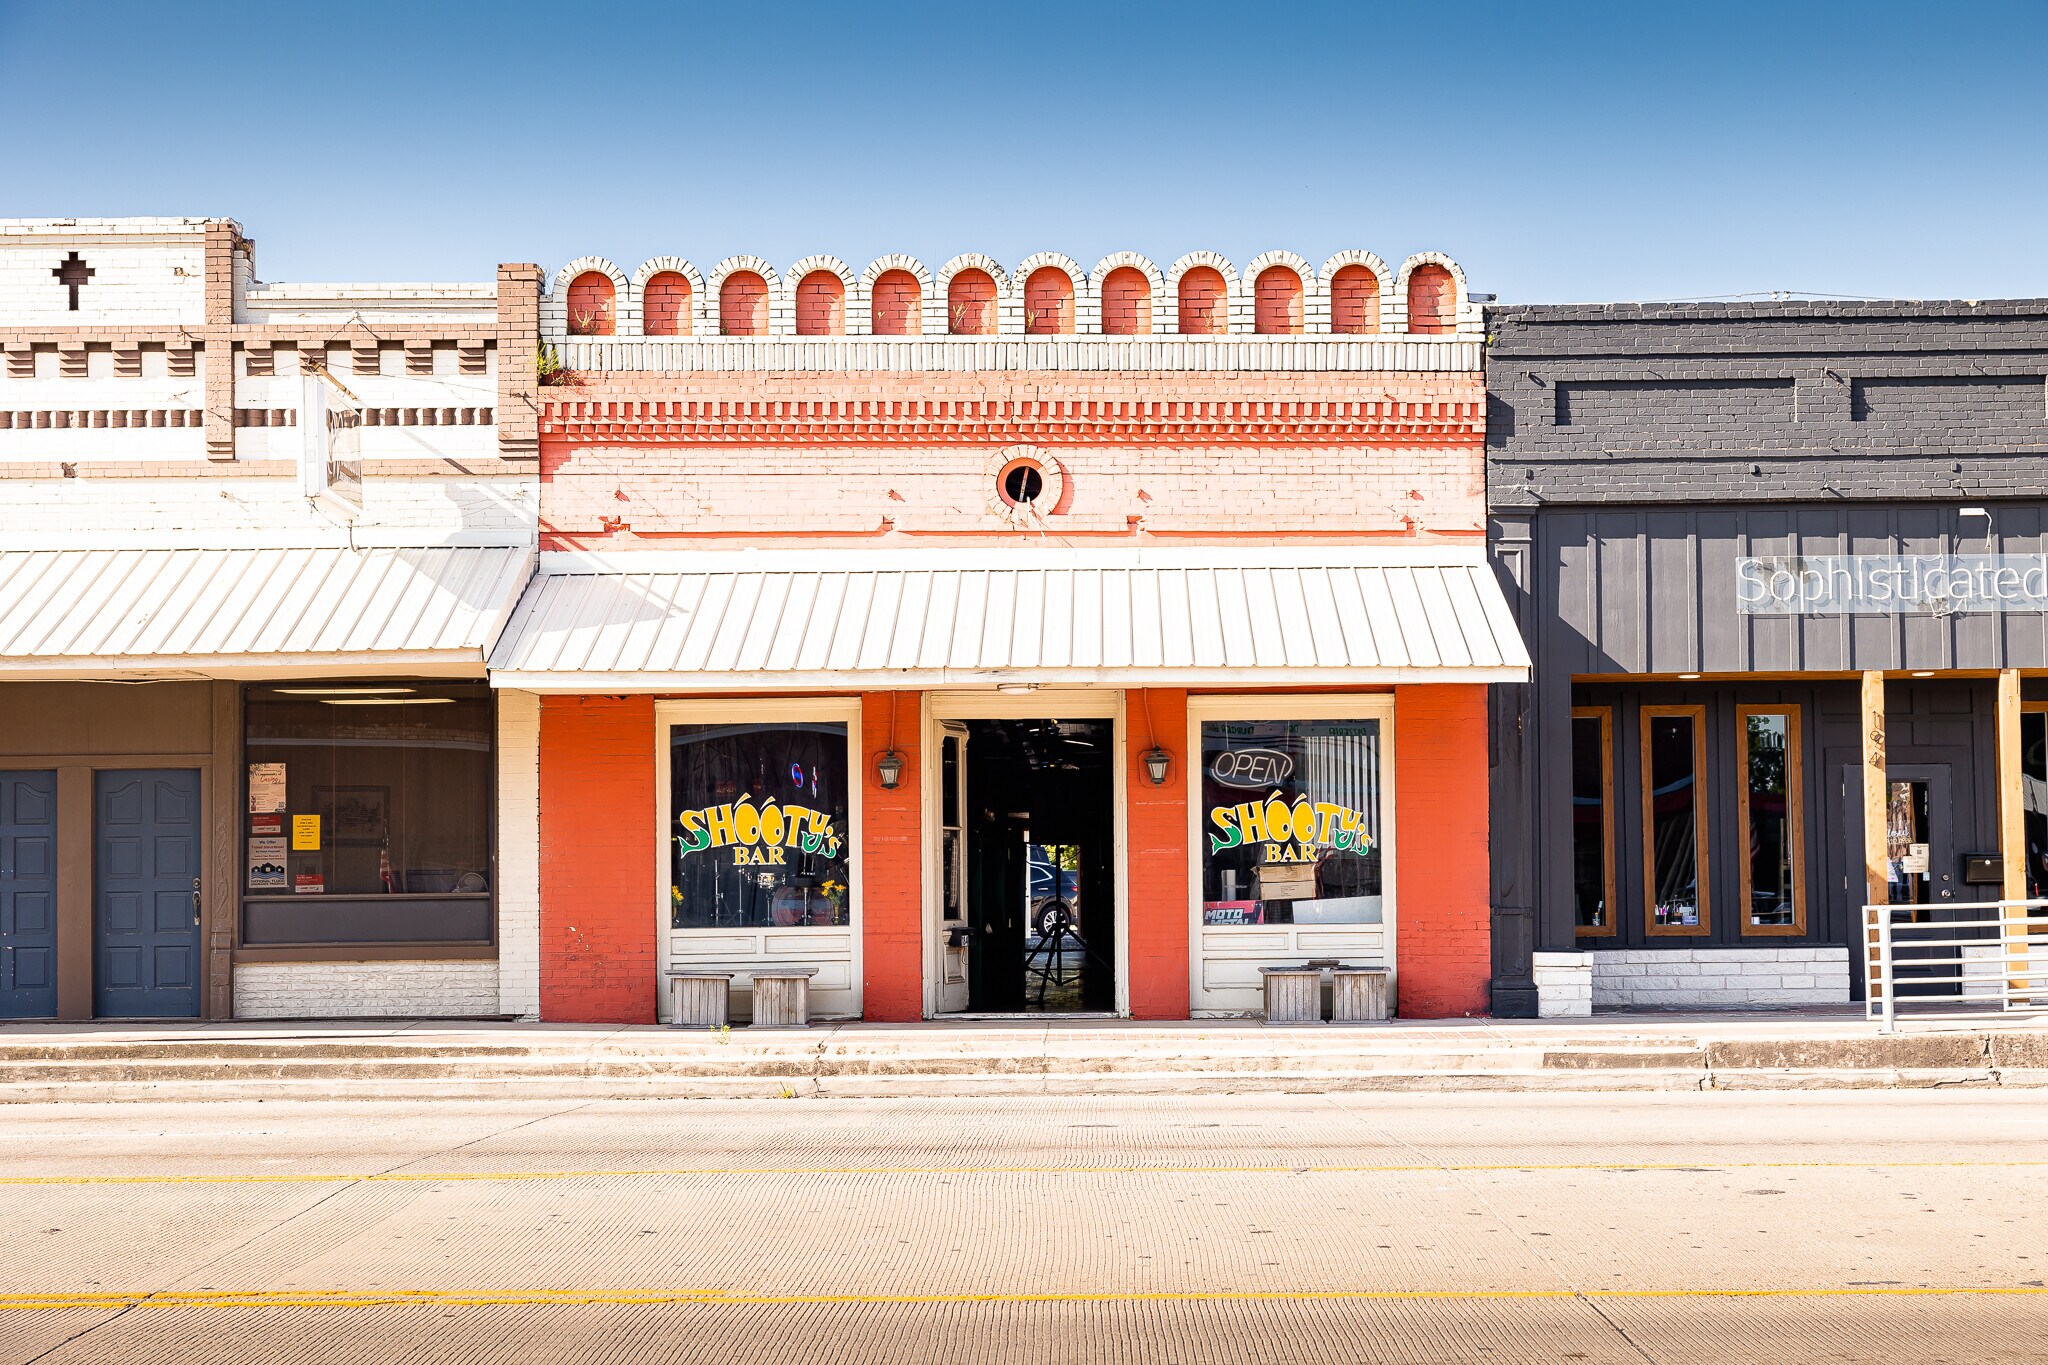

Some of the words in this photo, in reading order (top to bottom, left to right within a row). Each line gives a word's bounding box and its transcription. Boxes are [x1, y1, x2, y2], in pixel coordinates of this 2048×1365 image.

[1737, 554, 2048, 612] Sophisticated
[1215, 752, 1287, 784] OPEN
[733, 846, 786, 866] BAR
[1264, 843, 1319, 863] BAR
[1205, 909, 1244, 920] MOTO
